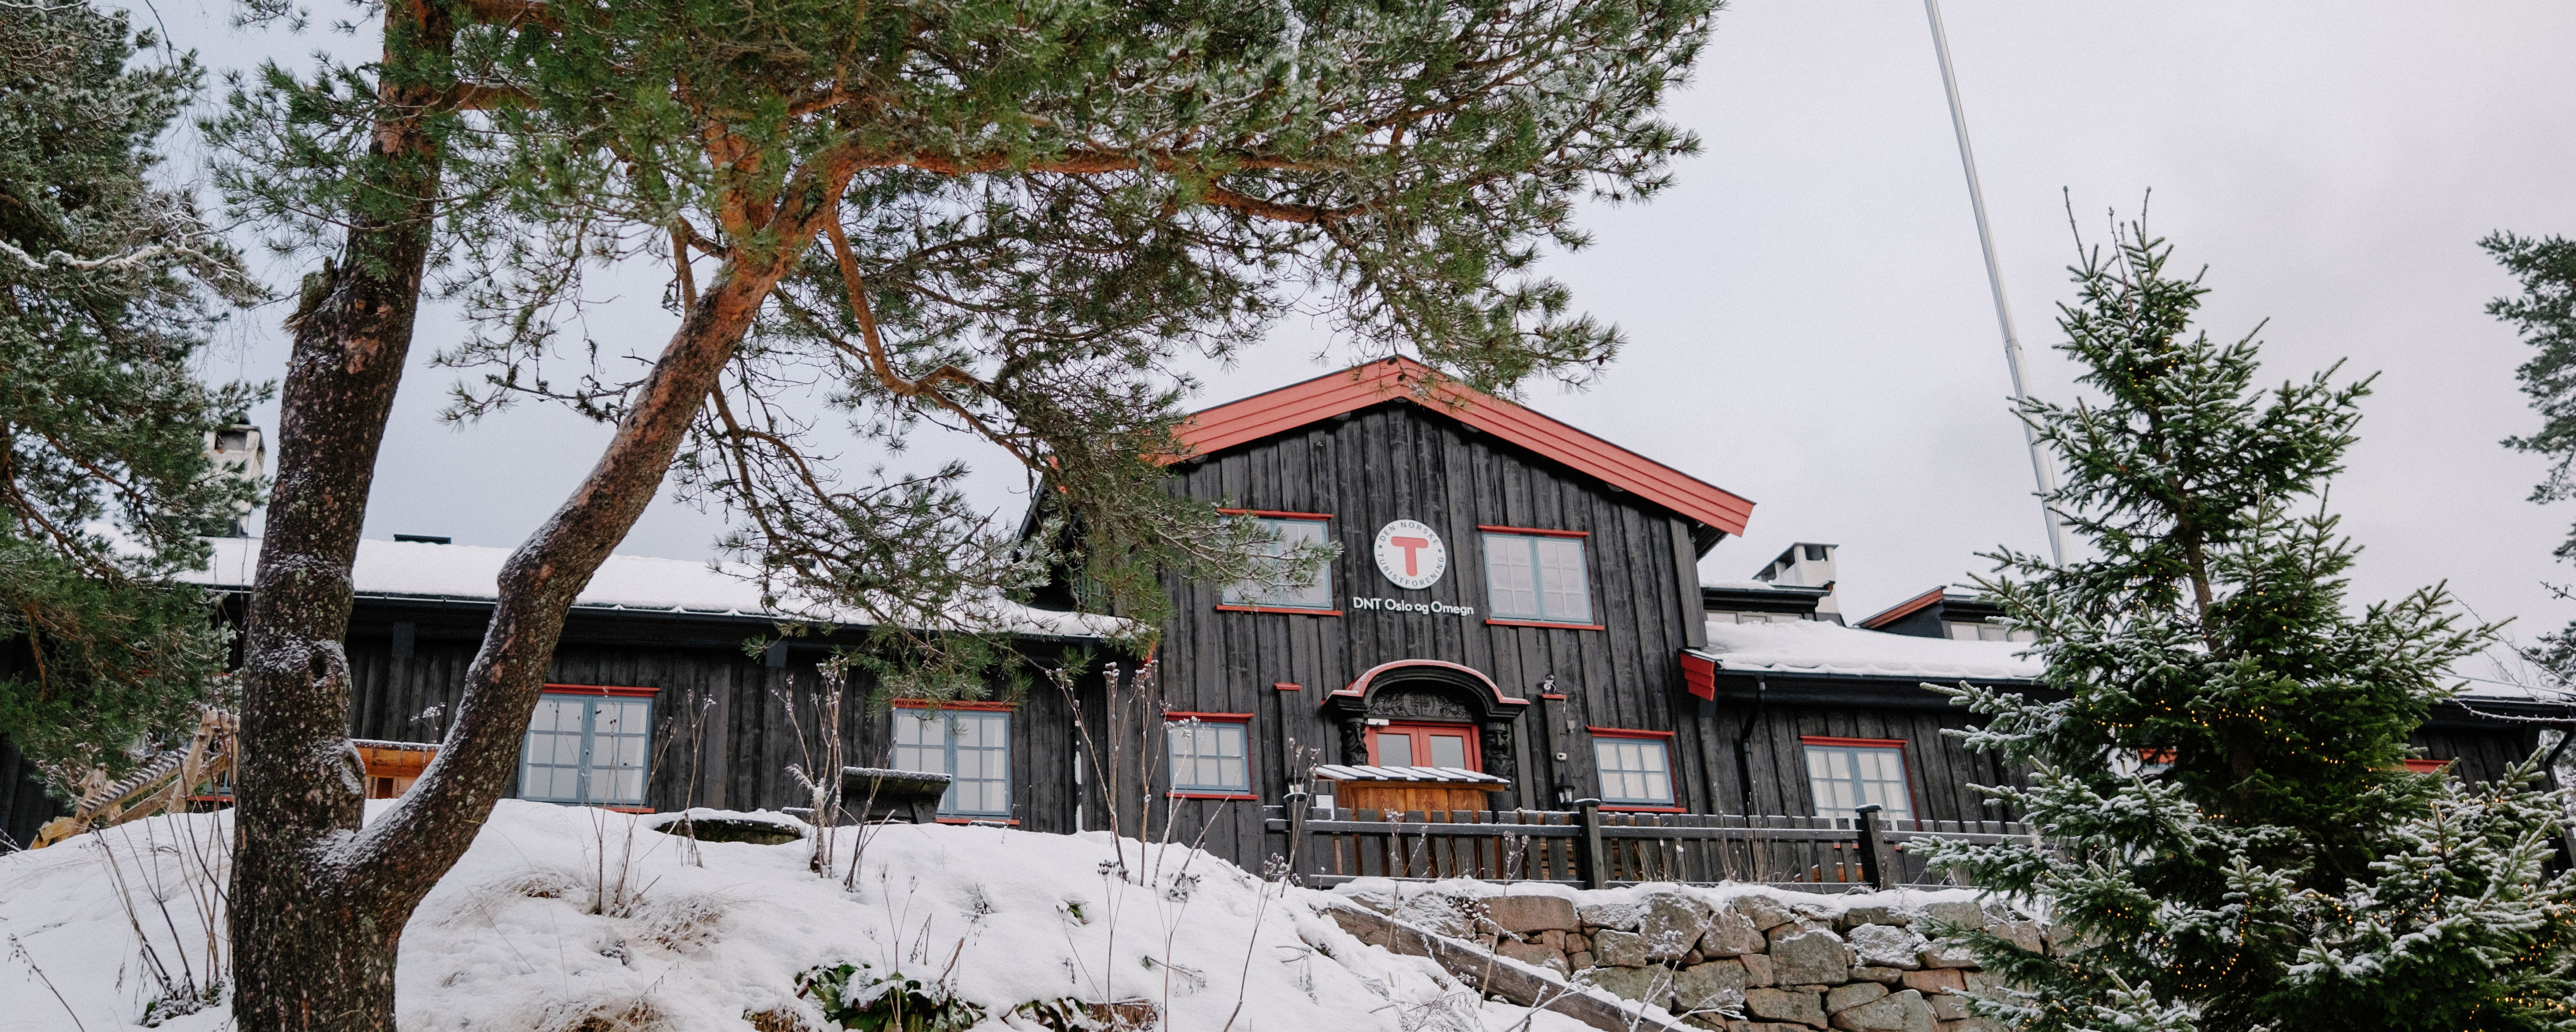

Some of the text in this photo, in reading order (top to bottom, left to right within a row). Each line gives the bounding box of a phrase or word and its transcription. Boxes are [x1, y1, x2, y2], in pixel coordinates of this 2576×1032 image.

[1379, 522, 1439, 545] DEN NORSKE
[1378, 553, 1444, 587] TURISTFORENING
[1391, 536, 1428, 577] T
[1353, 596, 1474, 616] DNT Oslo og Omegn
